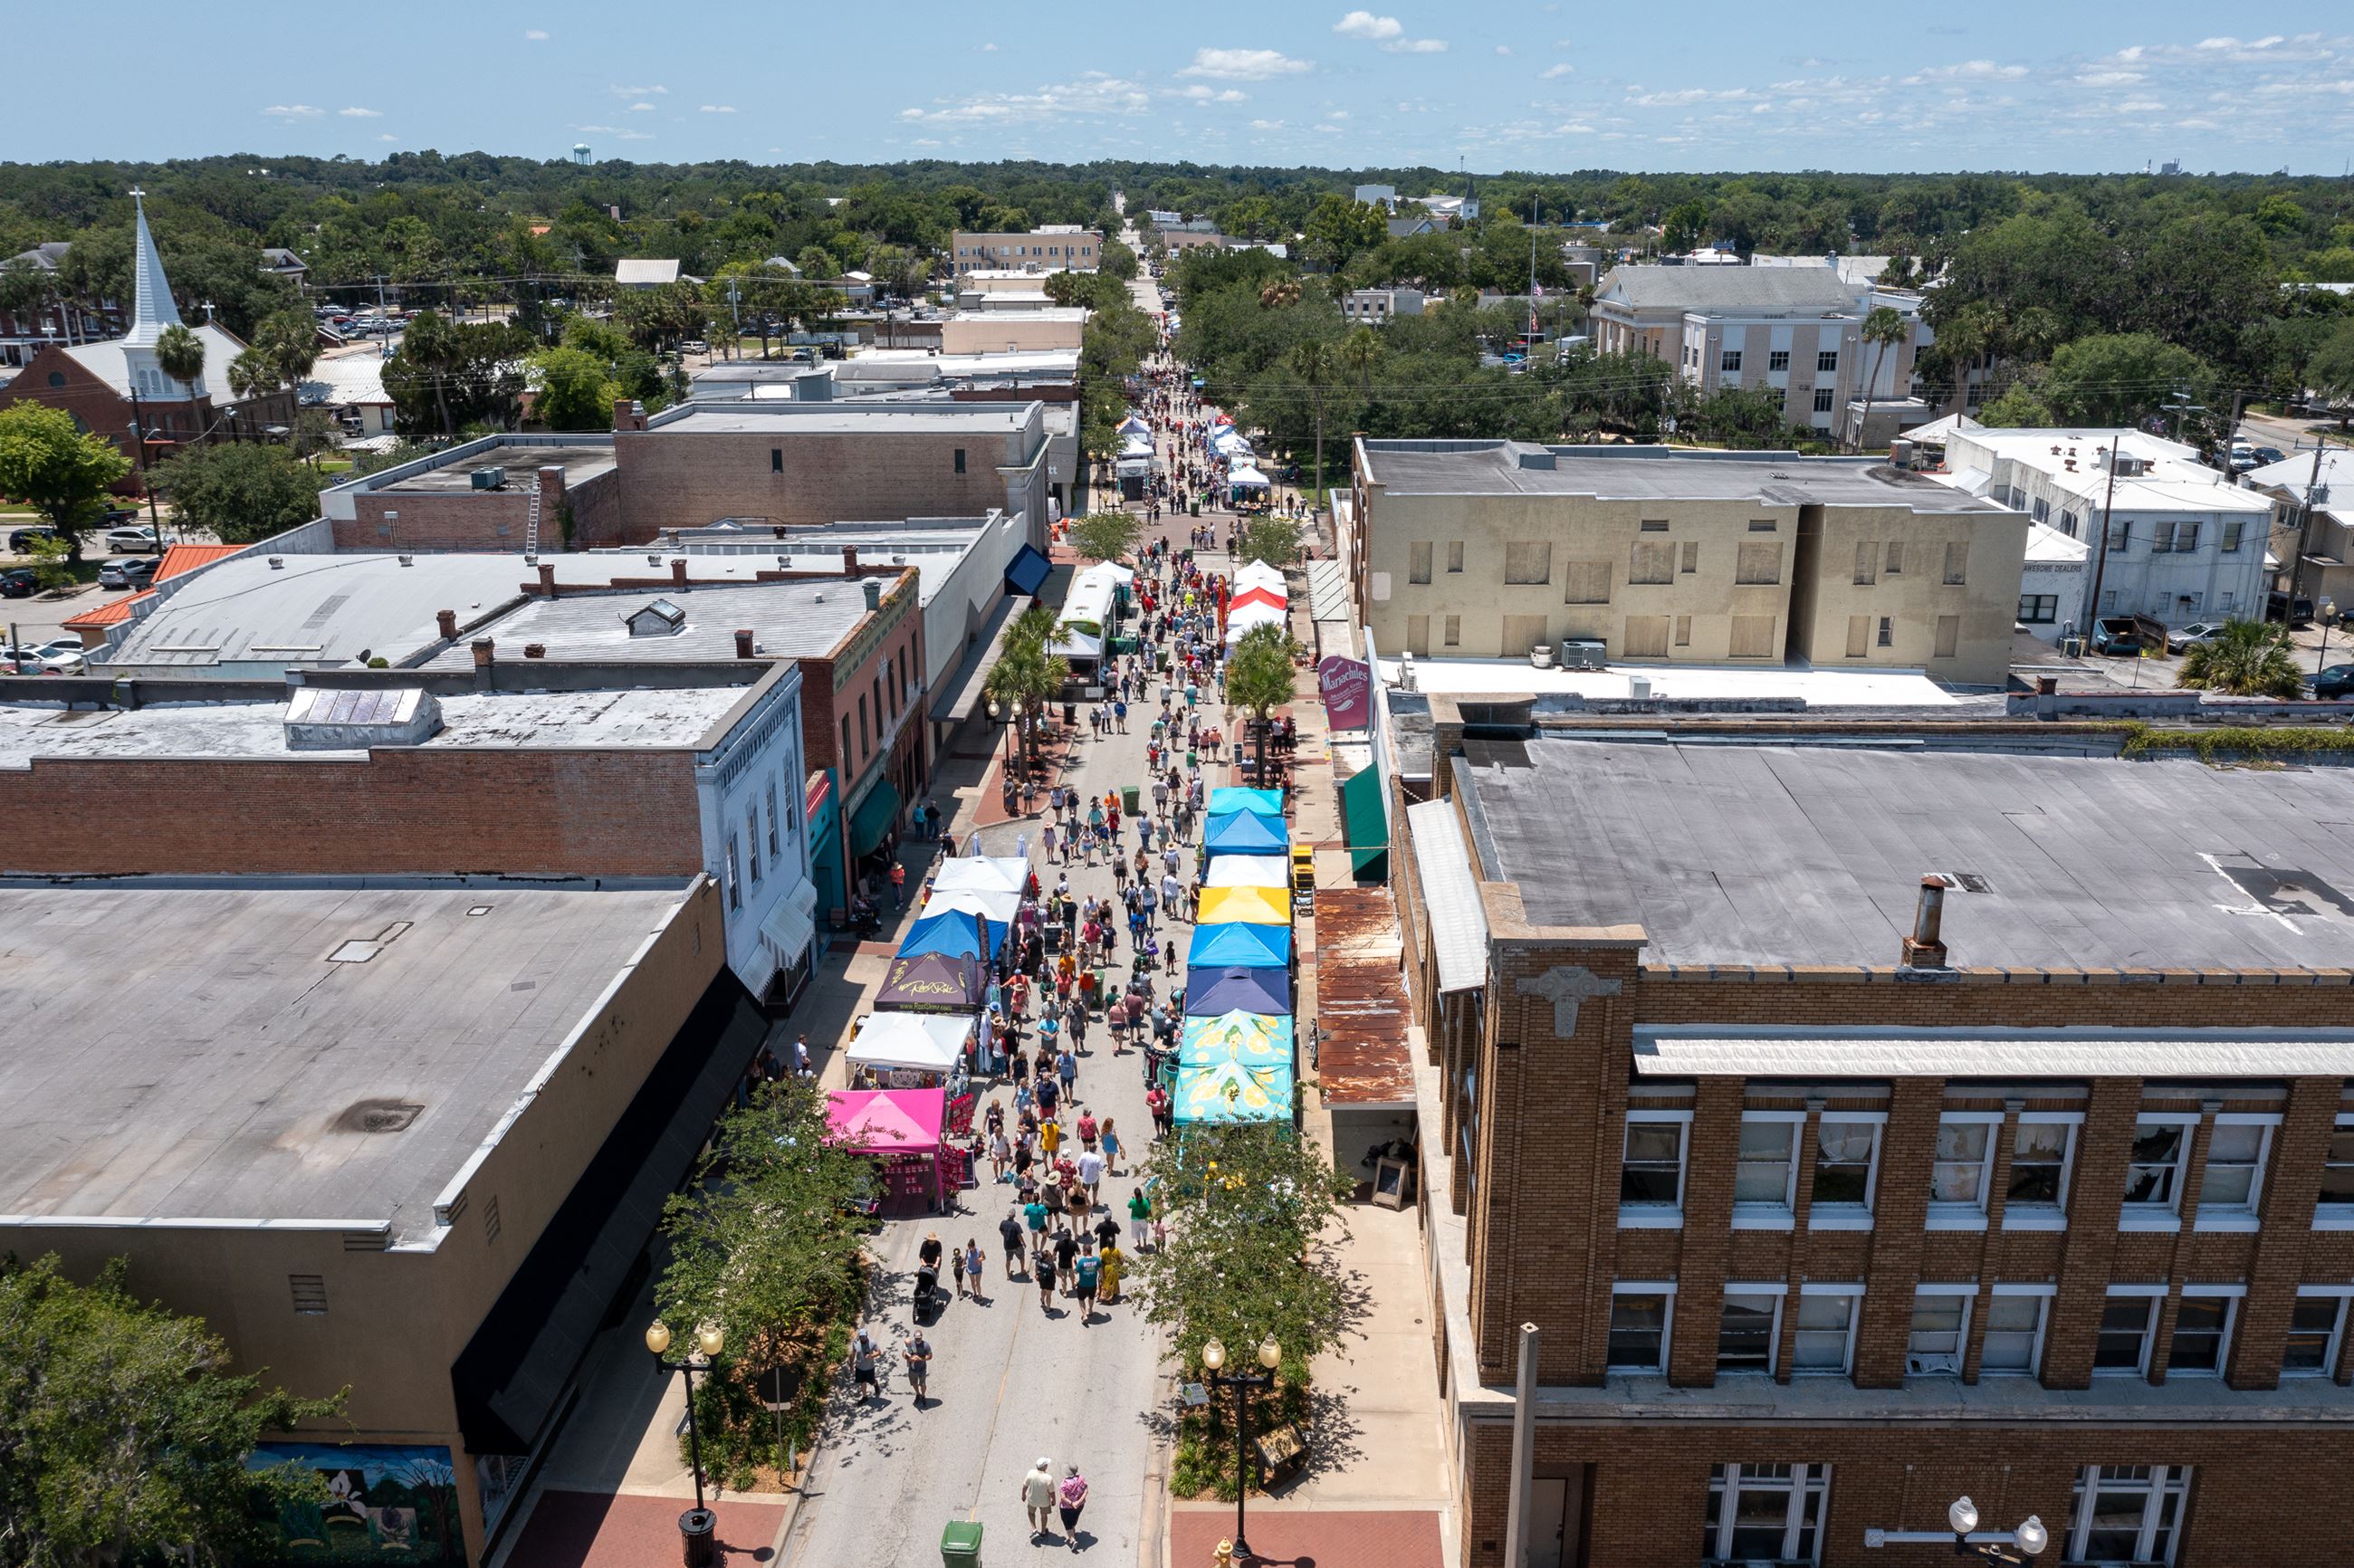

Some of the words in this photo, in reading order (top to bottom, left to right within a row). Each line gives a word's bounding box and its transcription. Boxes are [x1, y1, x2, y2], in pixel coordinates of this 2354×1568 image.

[2024, 564, 2053, 572] AWESOME
[2054, 564, 2082, 572] DEALERS
[1322, 664, 1368, 691] Mariachiles
